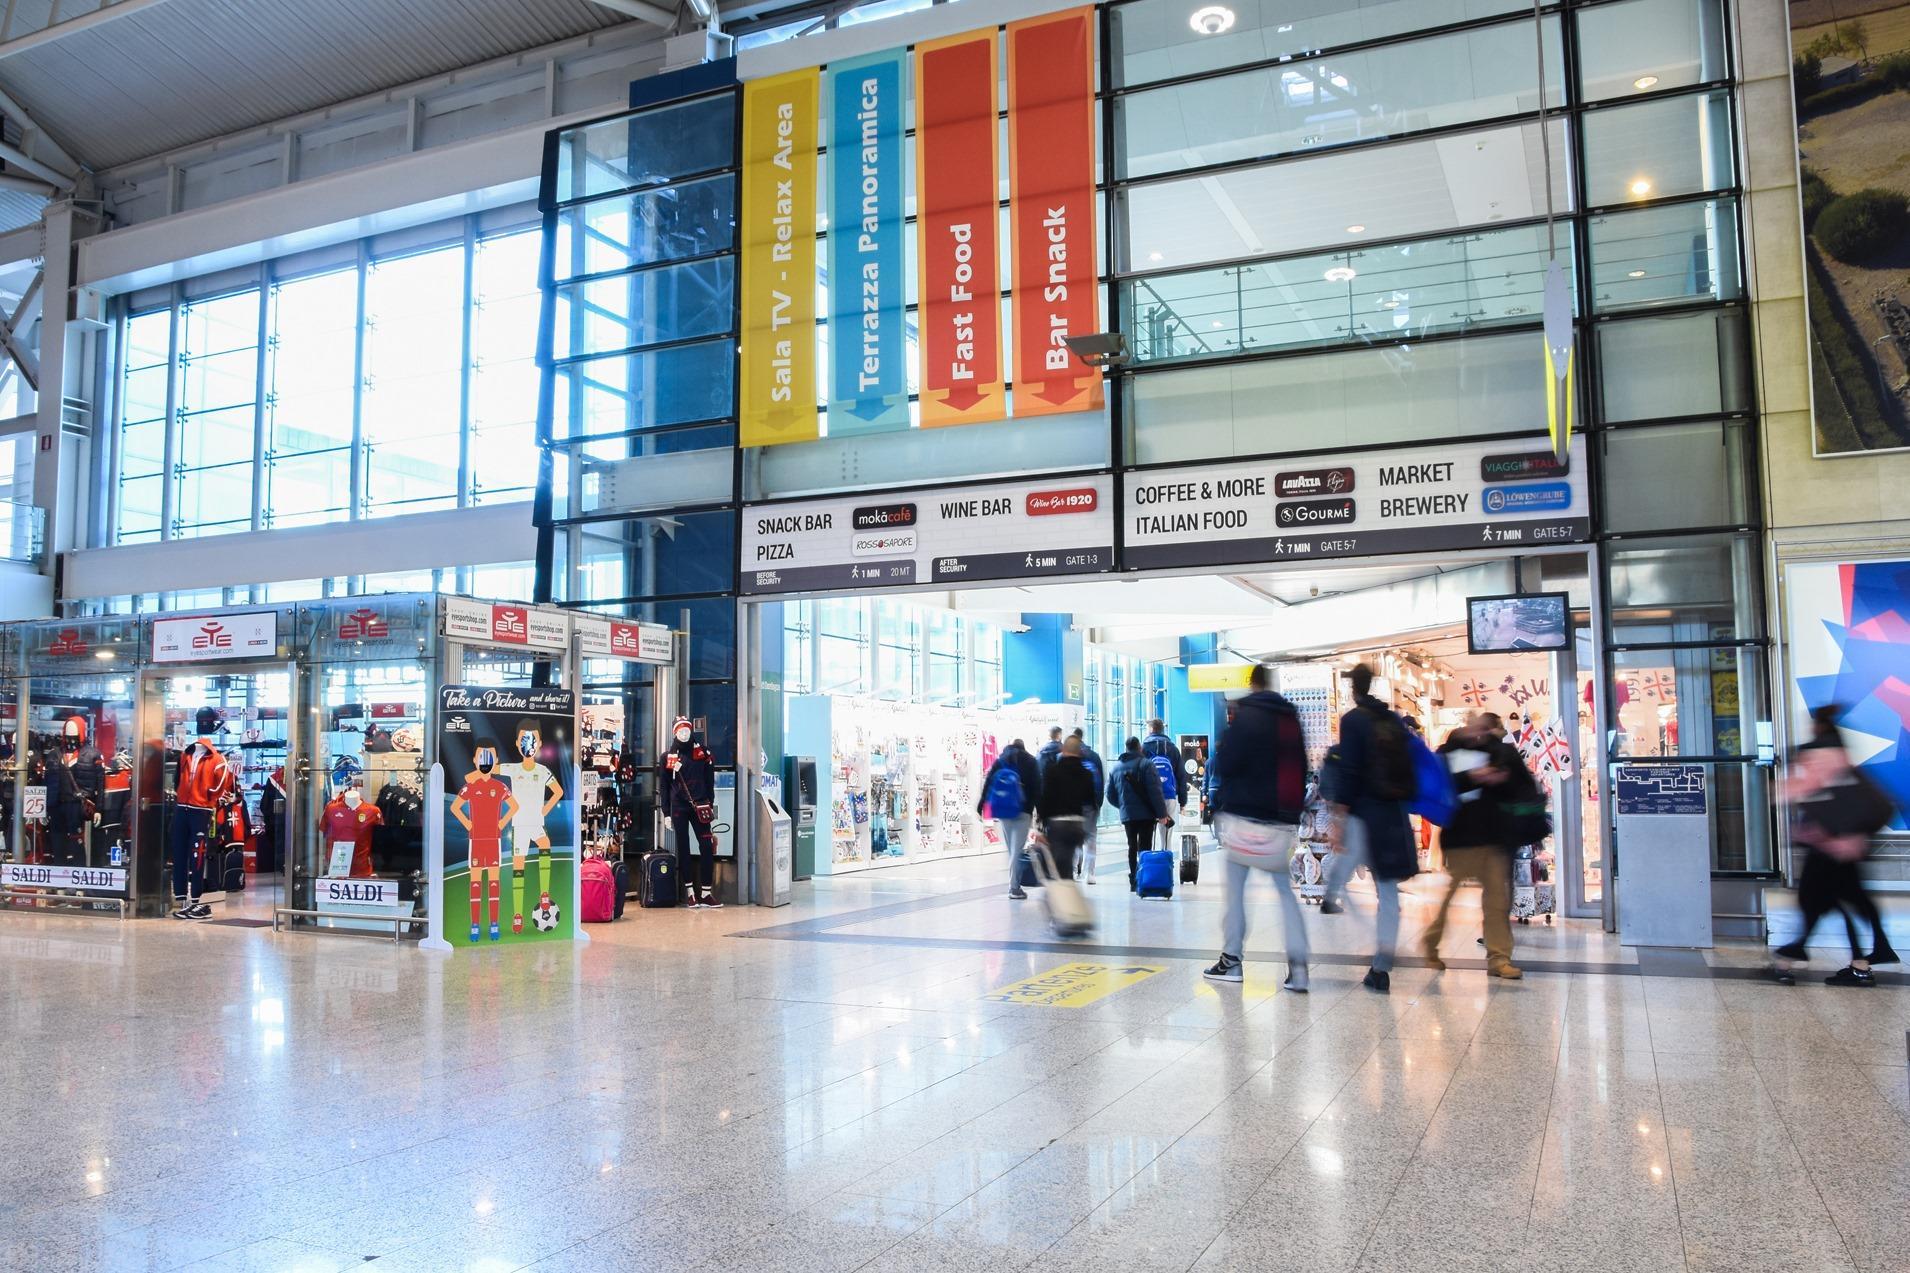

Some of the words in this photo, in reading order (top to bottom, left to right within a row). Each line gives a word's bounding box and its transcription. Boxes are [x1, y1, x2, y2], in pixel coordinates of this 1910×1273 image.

[773, 103, 793, 169] Area
[858, 78, 878, 253] Panoramica
[773, 179, 793, 261] Relax
[950, 223, 973, 302] Food
[1043, 205, 1067, 302] Snack
[773, 290, 791, 332] TV
[859, 263, 880, 392] Terrazza
[952, 312, 974, 380] Fast
[1046, 312, 1069, 370] Bar
[772, 339, 791, 402] Sala
[1282, 475, 1321, 490] LAVAZZA
[1379, 462, 1455, 486] MARKET
[1030, 498, 1050, 508] Wine
[1050, 496, 1066, 509] Bar
[1066, 494, 1093, 506] 1920
[1135, 483, 1197, 505] COFFEE
[1200, 481, 1212, 500] &
[1217, 477, 1266, 499] MORE
[940, 500, 978, 519] WINE
[981, 498, 1012, 516] BAR
[1380, 493, 1469, 518] BREWERY
[757, 515, 802, 535] SNACK
[805, 513, 832, 531] BAR
[1136, 512, 1199, 535] ITALIAN
[1203, 509, 1248, 530] FOOD
[1495, 530, 1502, 541] 7
[1503, 529, 1522, 540] MIN
[1533, 527, 1558, 539] GATE
[1559, 526, 1573, 537] 5-7
[757, 543, 794, 561] PIZZA
[1286, 544, 1293, 554] 7
[1293, 542, 1311, 553] MIN
[1320, 540, 1343, 552] GATE
[1343, 539, 1357, 550] 5-7
[939, 558, 958, 567] AFTER
[939, 564, 968, 573] SECURITY
[1035, 558, 1041, 567] 5
[1041, 557, 1057, 567] MIN
[1065, 555, 1086, 566] GATE
[1086, 554, 1098, 565] 1-3
[756, 571, 777, 579] BEFORE
[756, 578, 782, 586] SECURITY
[861, 570, 866, 578] 1
[866, 568, 881, 578] MIN
[890, 567, 900, 577] 20
[899, 566, 911, 576] MT
[495, 611, 524, 633] EYE
[192, 622, 232, 649] EYE
[613, 628, 637, 648] EYE
[443, 689, 471, 708] Take
[472, 698, 482, 709] a
[483, 689, 527, 709] Picture
[529, 693, 545, 702] and
[761, 775, 779, 788] OMAT
[26, 799, 44, 815] 25
[11, 867, 52, 884] SALDI
[71, 869, 114, 887] SALDI
[329, 883, 384, 902] SALDI
